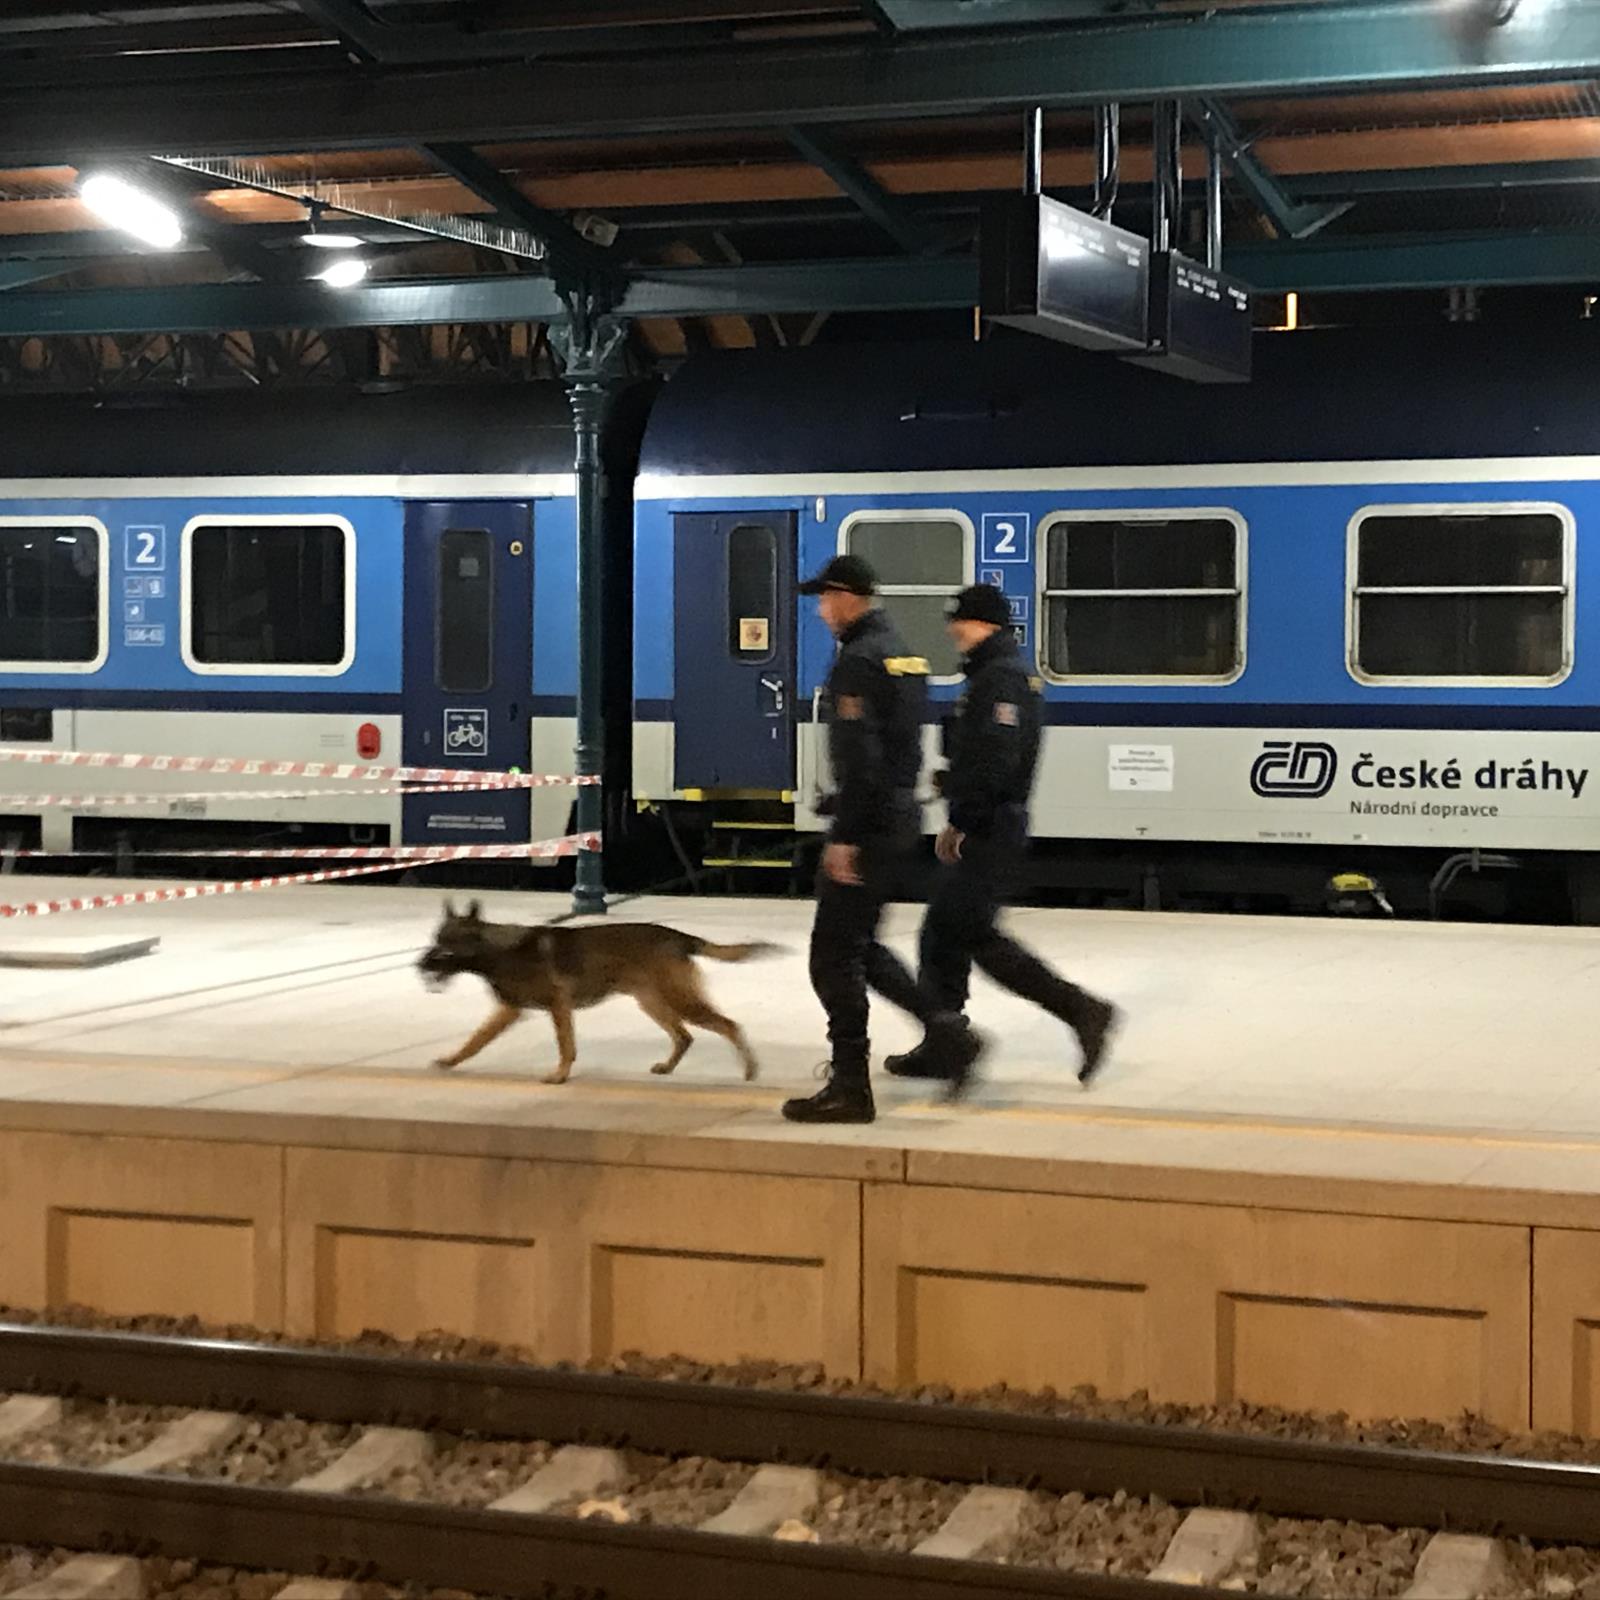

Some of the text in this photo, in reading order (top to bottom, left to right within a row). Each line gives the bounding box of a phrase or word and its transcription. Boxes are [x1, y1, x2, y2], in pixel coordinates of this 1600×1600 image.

[135, 532, 156, 564] 2
[994, 522, 1017, 554] 2
[1351, 752, 1590, 799] České dráhy
[1350, 800, 1499, 819] Národní dopravce
